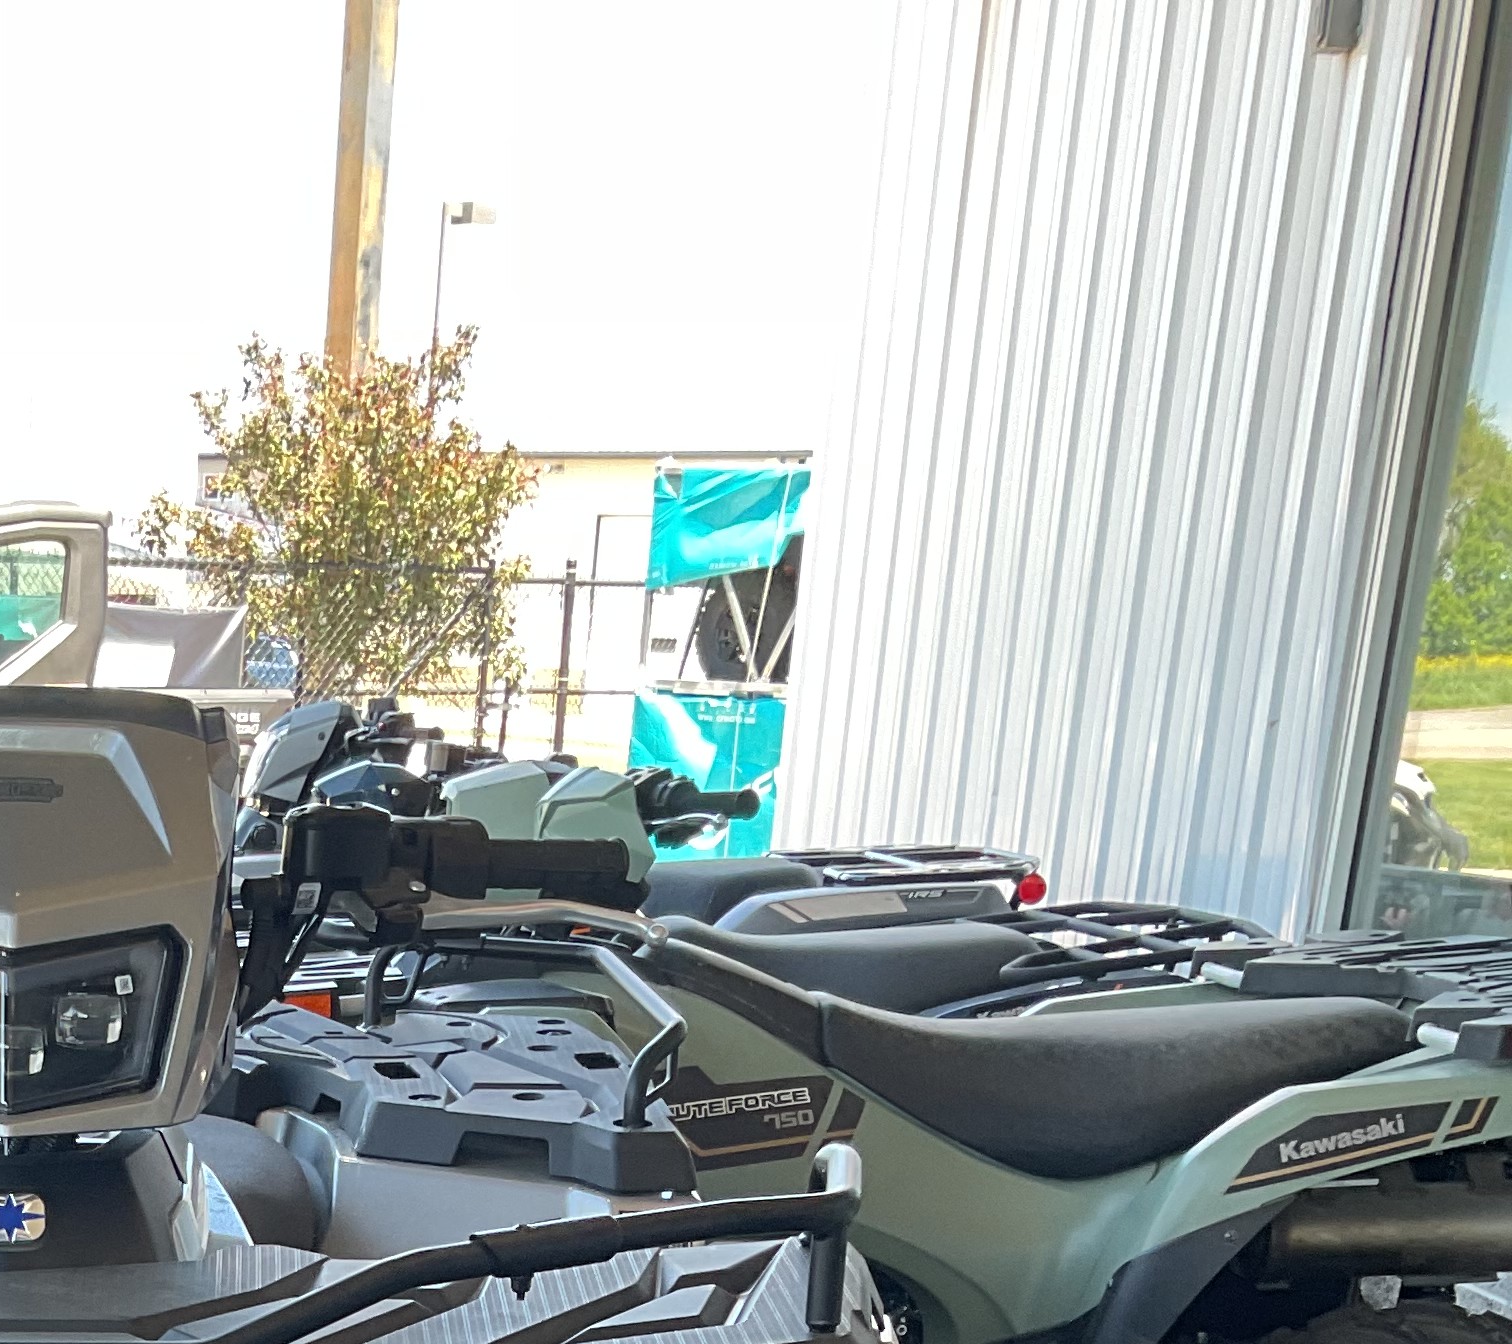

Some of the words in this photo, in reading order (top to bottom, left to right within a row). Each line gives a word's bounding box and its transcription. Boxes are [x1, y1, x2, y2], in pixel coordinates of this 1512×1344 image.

[670, 1098, 727, 1122] UTE
[725, 1087, 811, 1114] FORCE
[763, 1109, 815, 1130] 750
[1279, 1113, 1406, 1164] Kawasaki
